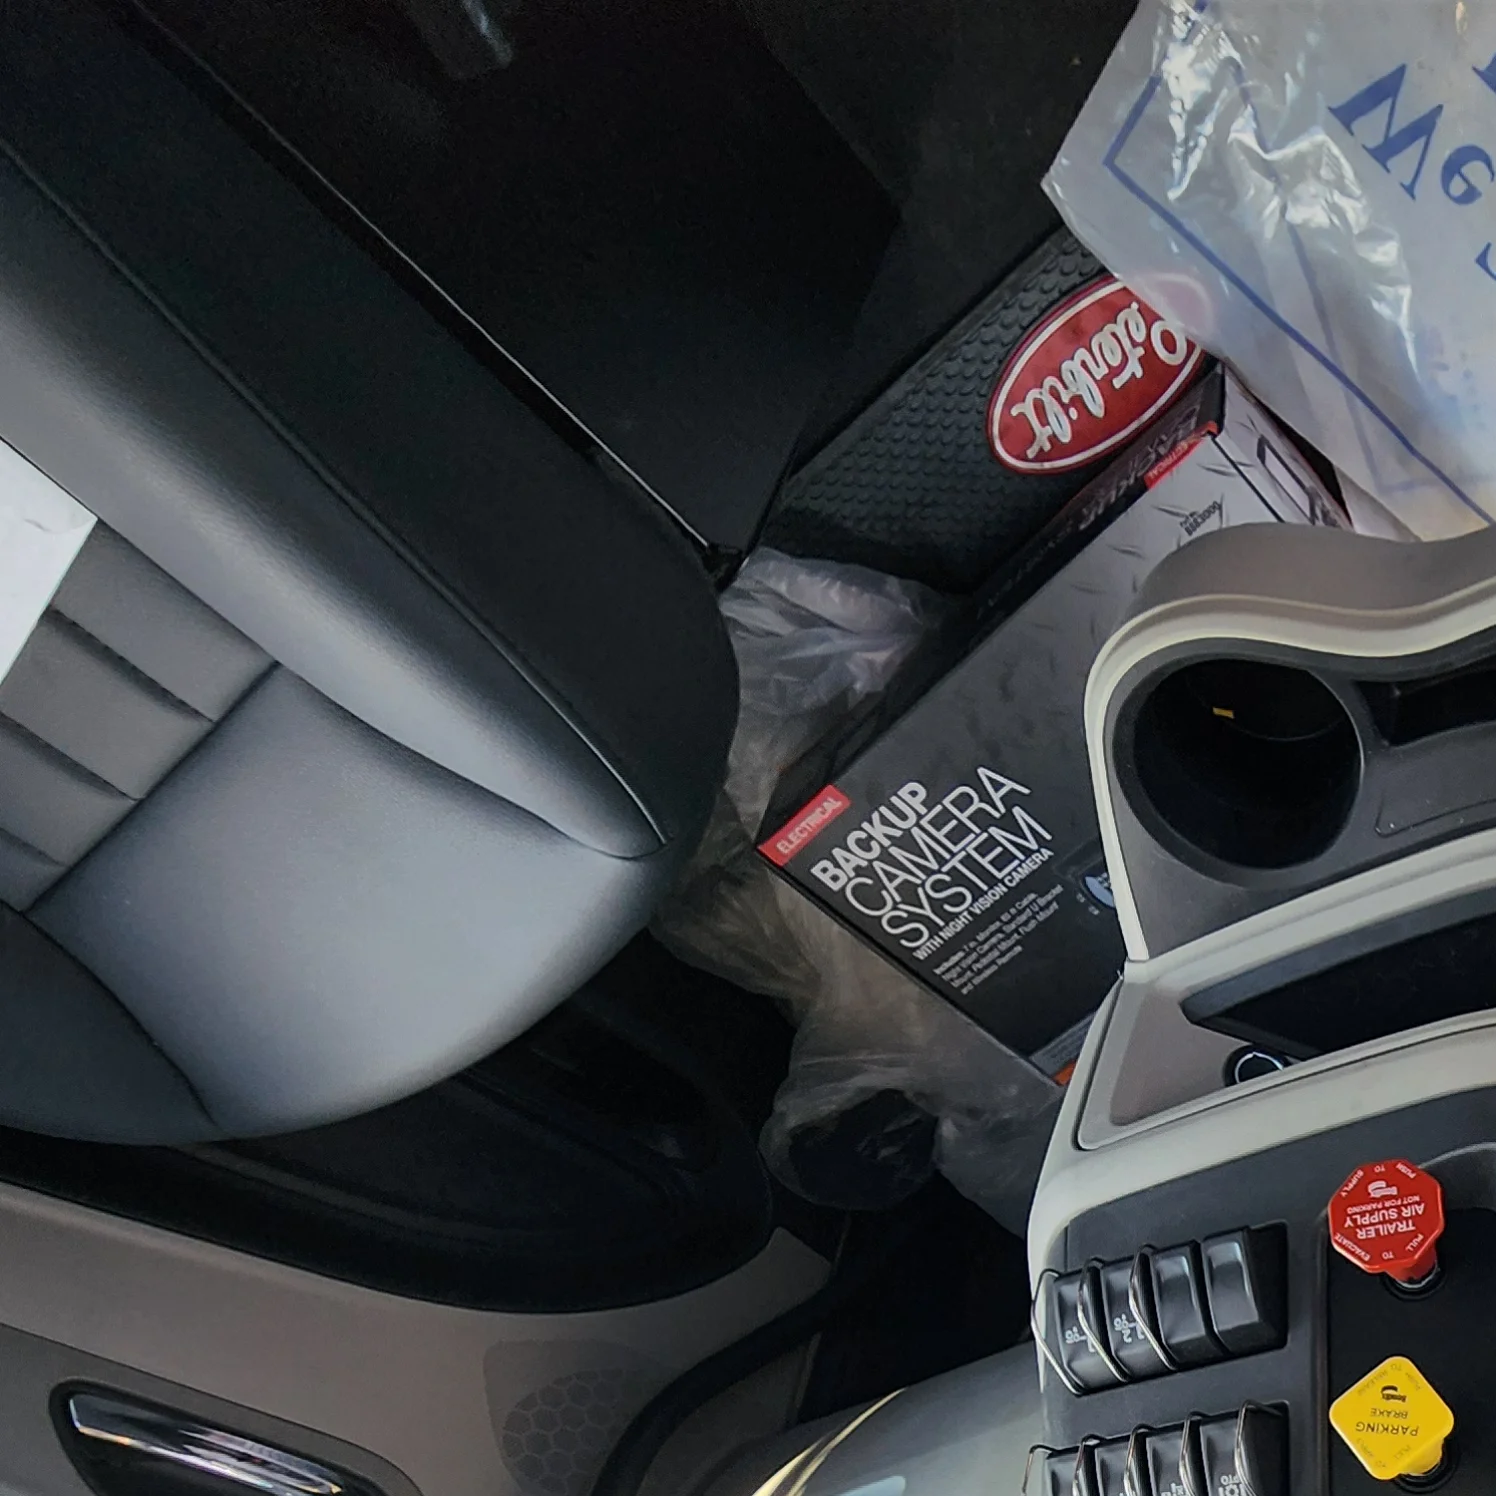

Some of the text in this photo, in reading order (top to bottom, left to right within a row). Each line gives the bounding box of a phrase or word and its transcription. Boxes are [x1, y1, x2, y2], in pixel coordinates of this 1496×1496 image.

[1010, 301, 1189, 459] Peterbilt
[776, 797, 842, 854] ELECTRICAL
[809, 778, 937, 891] BACKUP
[840, 764, 1032, 923] CAMERA
[877, 803, 1053, 953] SYSTEM
[913, 848, 1054, 961] WITH NIGHT VISION CAMERA
[1340, 1162, 1416, 1197] PUSH TO SUPPLY
[1344, 1202, 1425, 1227] AIR SUPPLY
[1347, 1195, 1420, 1214] NOT FOR PARKING
[1355, 1219, 1416, 1239] TRAILER
[1405, 1233, 1424, 1251] PULL
[1333, 1232, 1371, 1261] EVACUATE
[1356, 1421, 1419, 1436] PARKING
[1370, 1408, 1408, 1419] BRAKE
